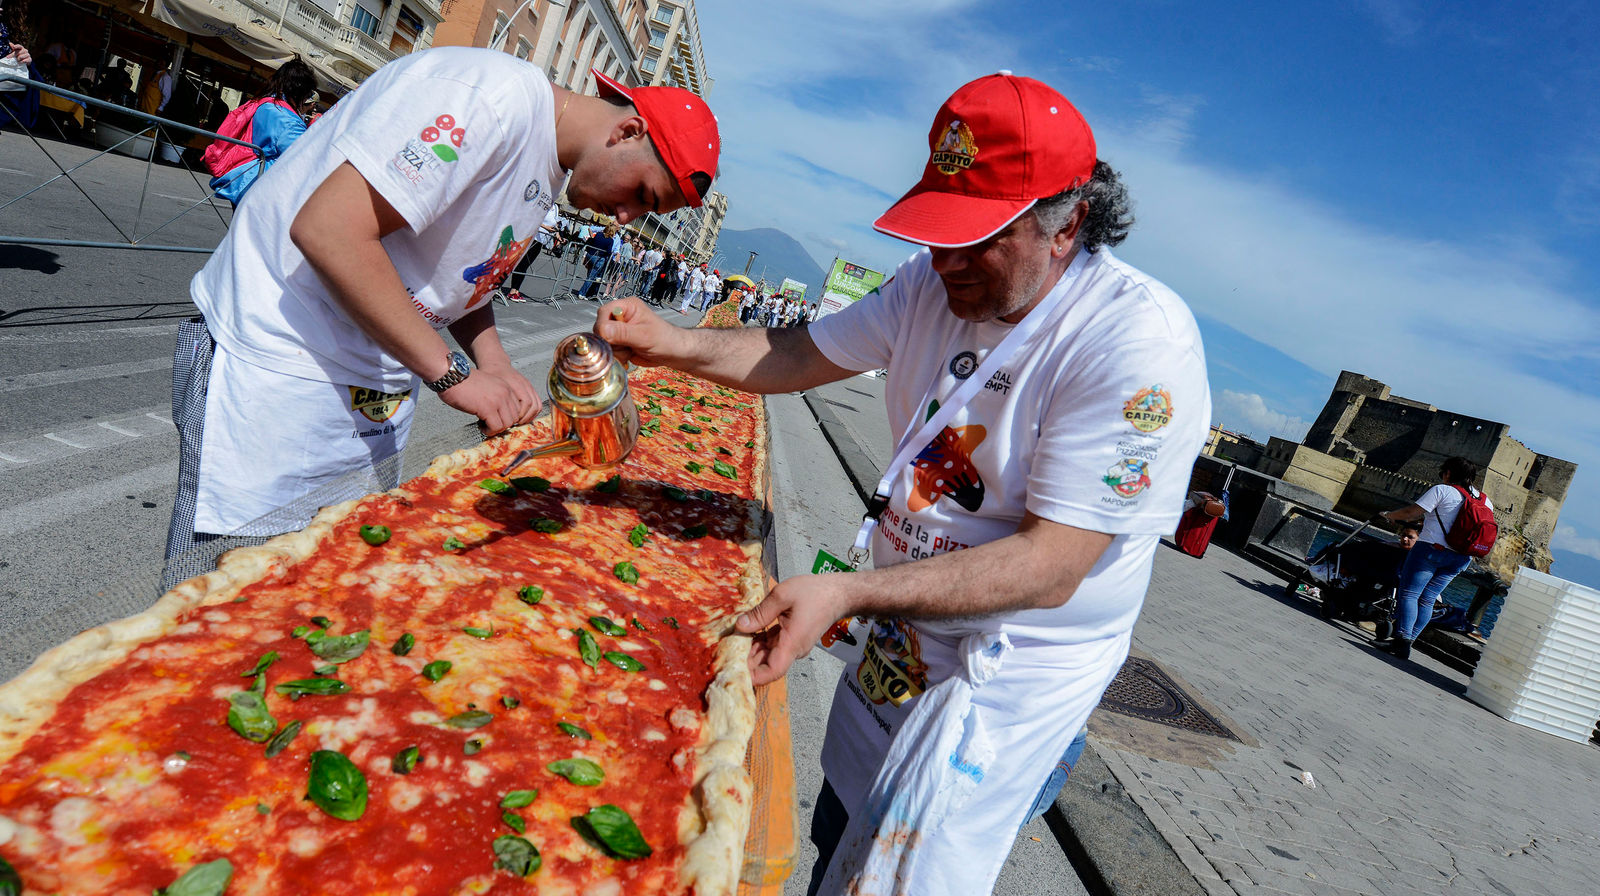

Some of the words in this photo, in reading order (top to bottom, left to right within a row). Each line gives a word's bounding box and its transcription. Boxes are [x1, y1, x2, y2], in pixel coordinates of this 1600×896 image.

[934, 154, 970, 166] CAPUTO
[984, 380, 1009, 395] EMPT
[1125, 411, 1169, 424] CAPUTO
[881, 520, 909, 554] lunga
[900, 517, 913, 536] fa
[915, 525, 929, 544] la
[932, 535, 975, 552] pizz
[862, 671, 876, 695] 1924
